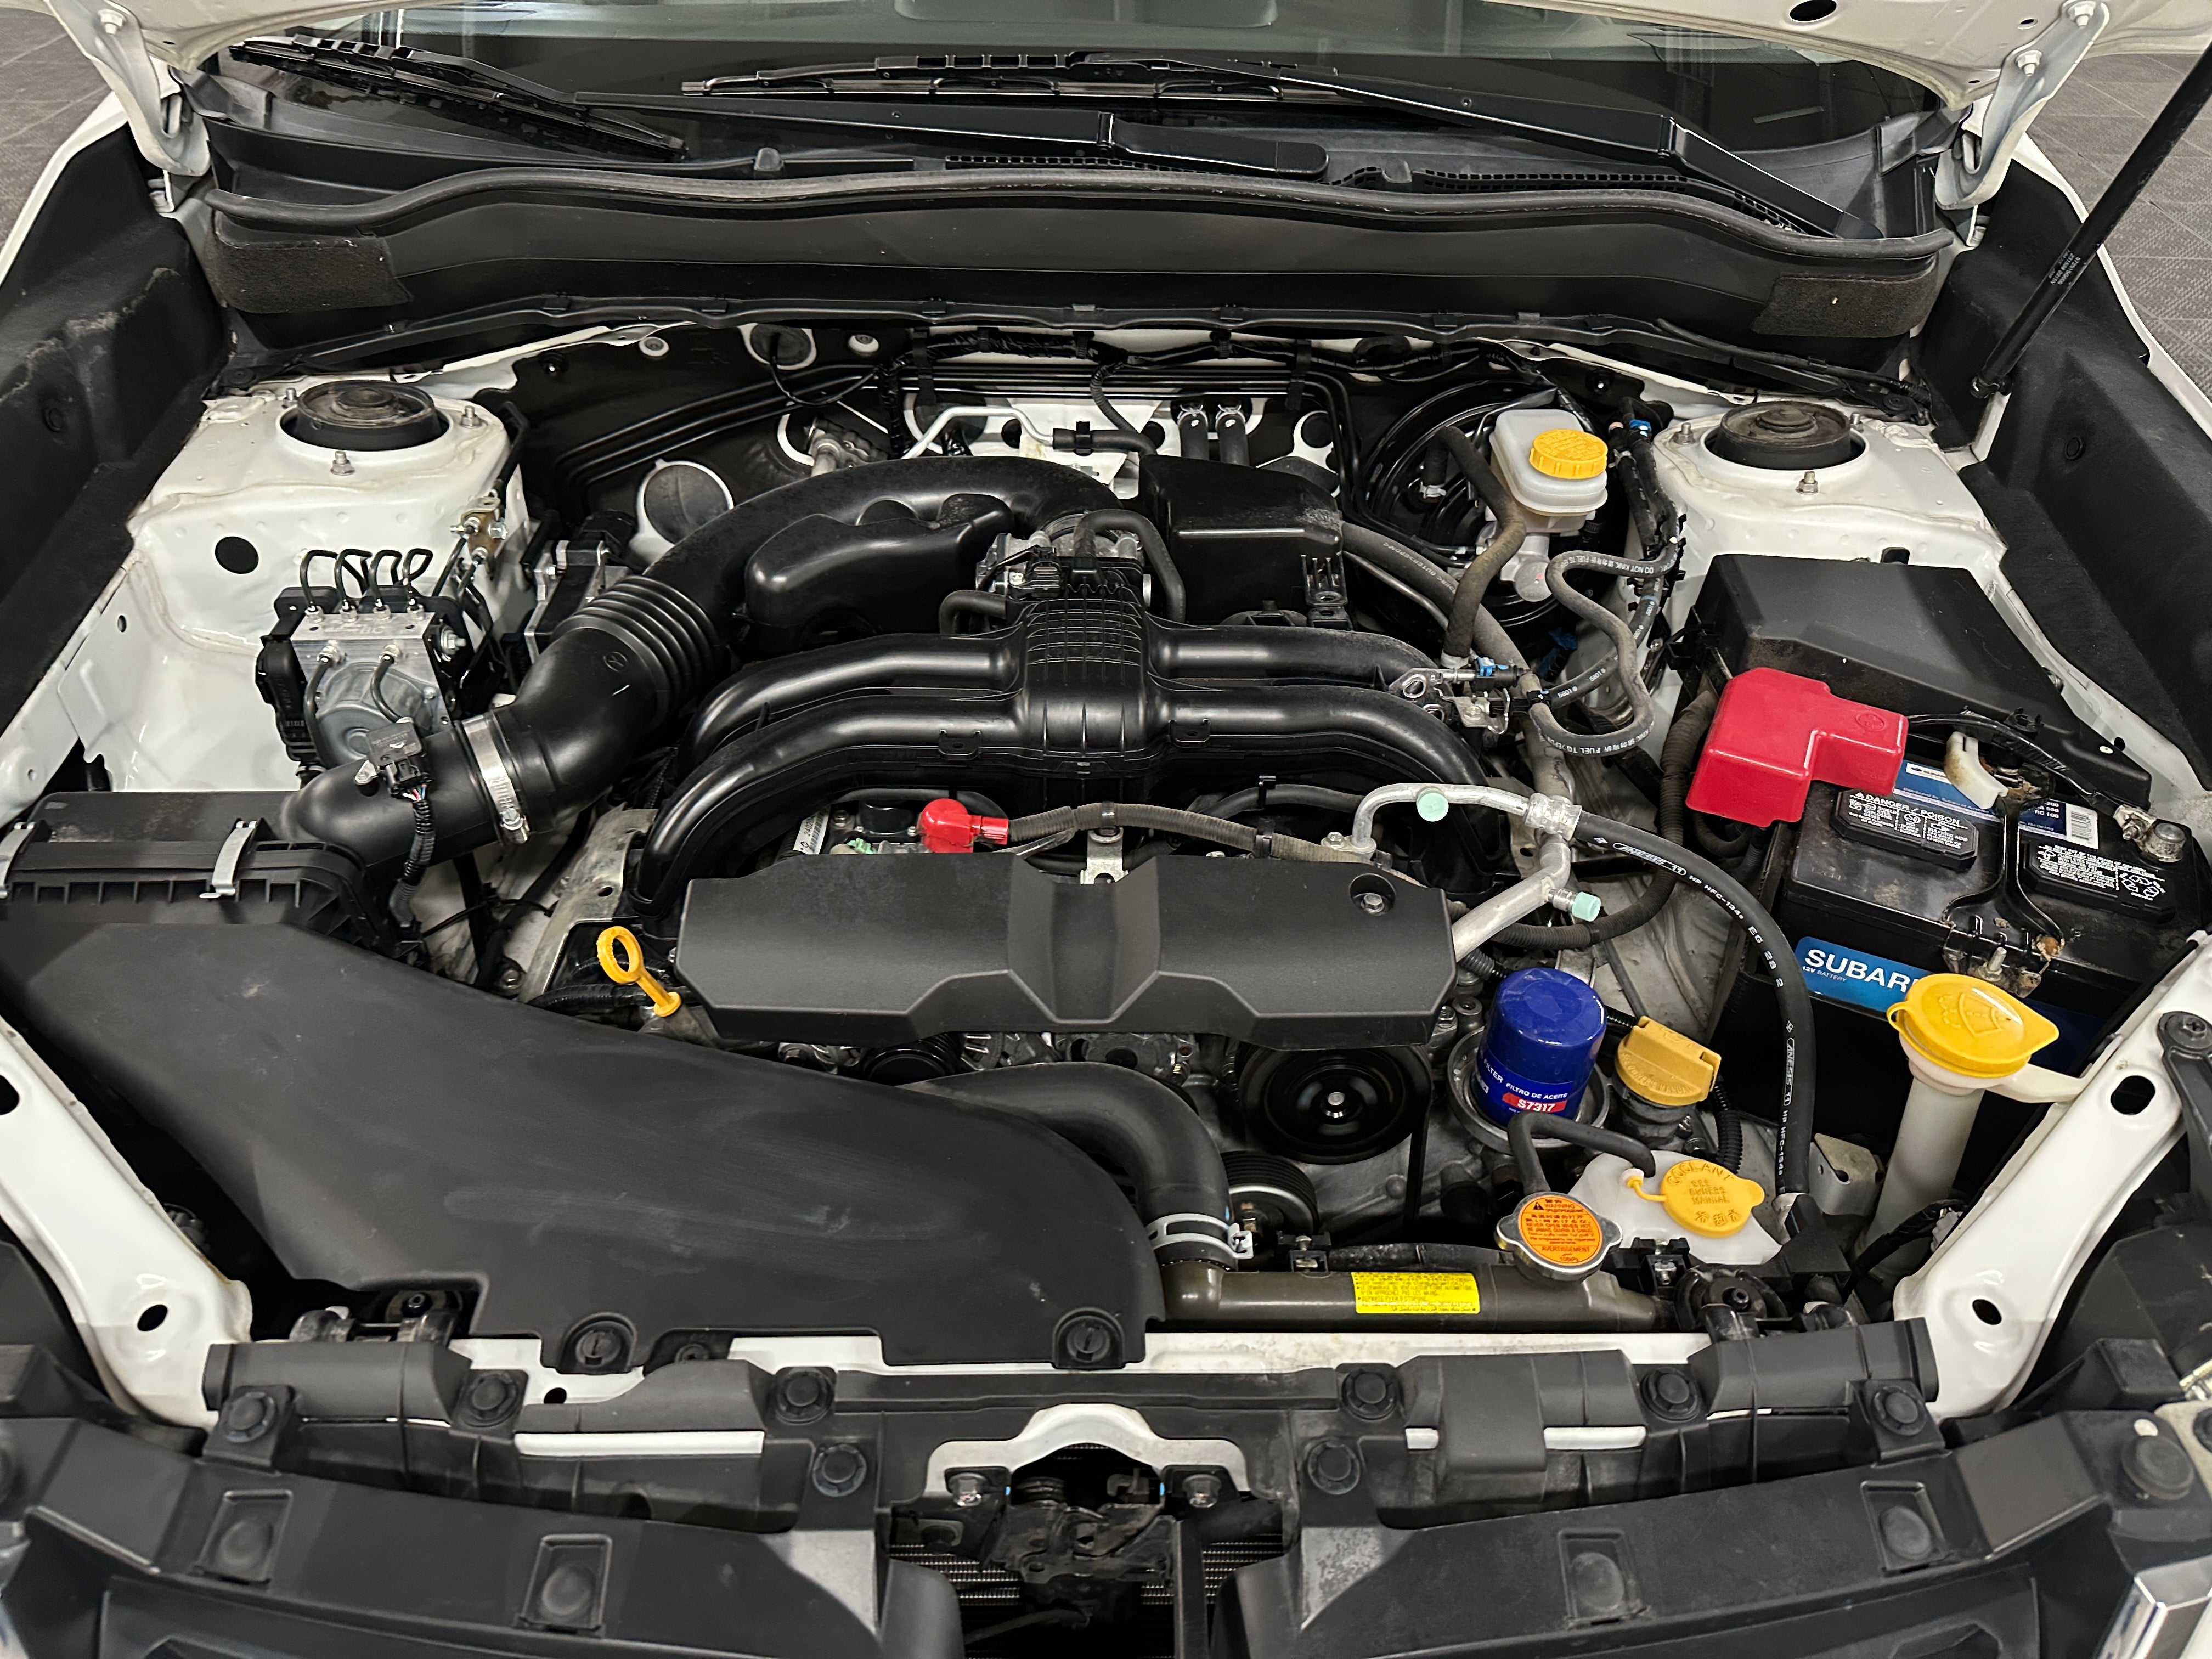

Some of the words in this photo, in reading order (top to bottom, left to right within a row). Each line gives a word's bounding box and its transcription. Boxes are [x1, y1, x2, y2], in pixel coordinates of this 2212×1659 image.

[1630, 566, 1644, 574] NOT
[1866, 794, 1909, 811] DANGER
[1920, 810, 1960, 825] POISON
[1689, 875, 1702, 884] HP
[1704, 884, 1744, 919] HFC-134a
[1748, 926, 1763, 944] EG
[1802, 966, 1816, 974] 12V
[1816, 970, 1848, 983] BATTERY
[1805, 949, 1921, 994] SUBAR
[1506, 1082, 1530, 1096] FILTRO
[1517, 1099, 1556, 1112] S7317
[1667, 1161, 1734, 1185] COOLANT
[1691, 1179, 1711, 1188] SEE
